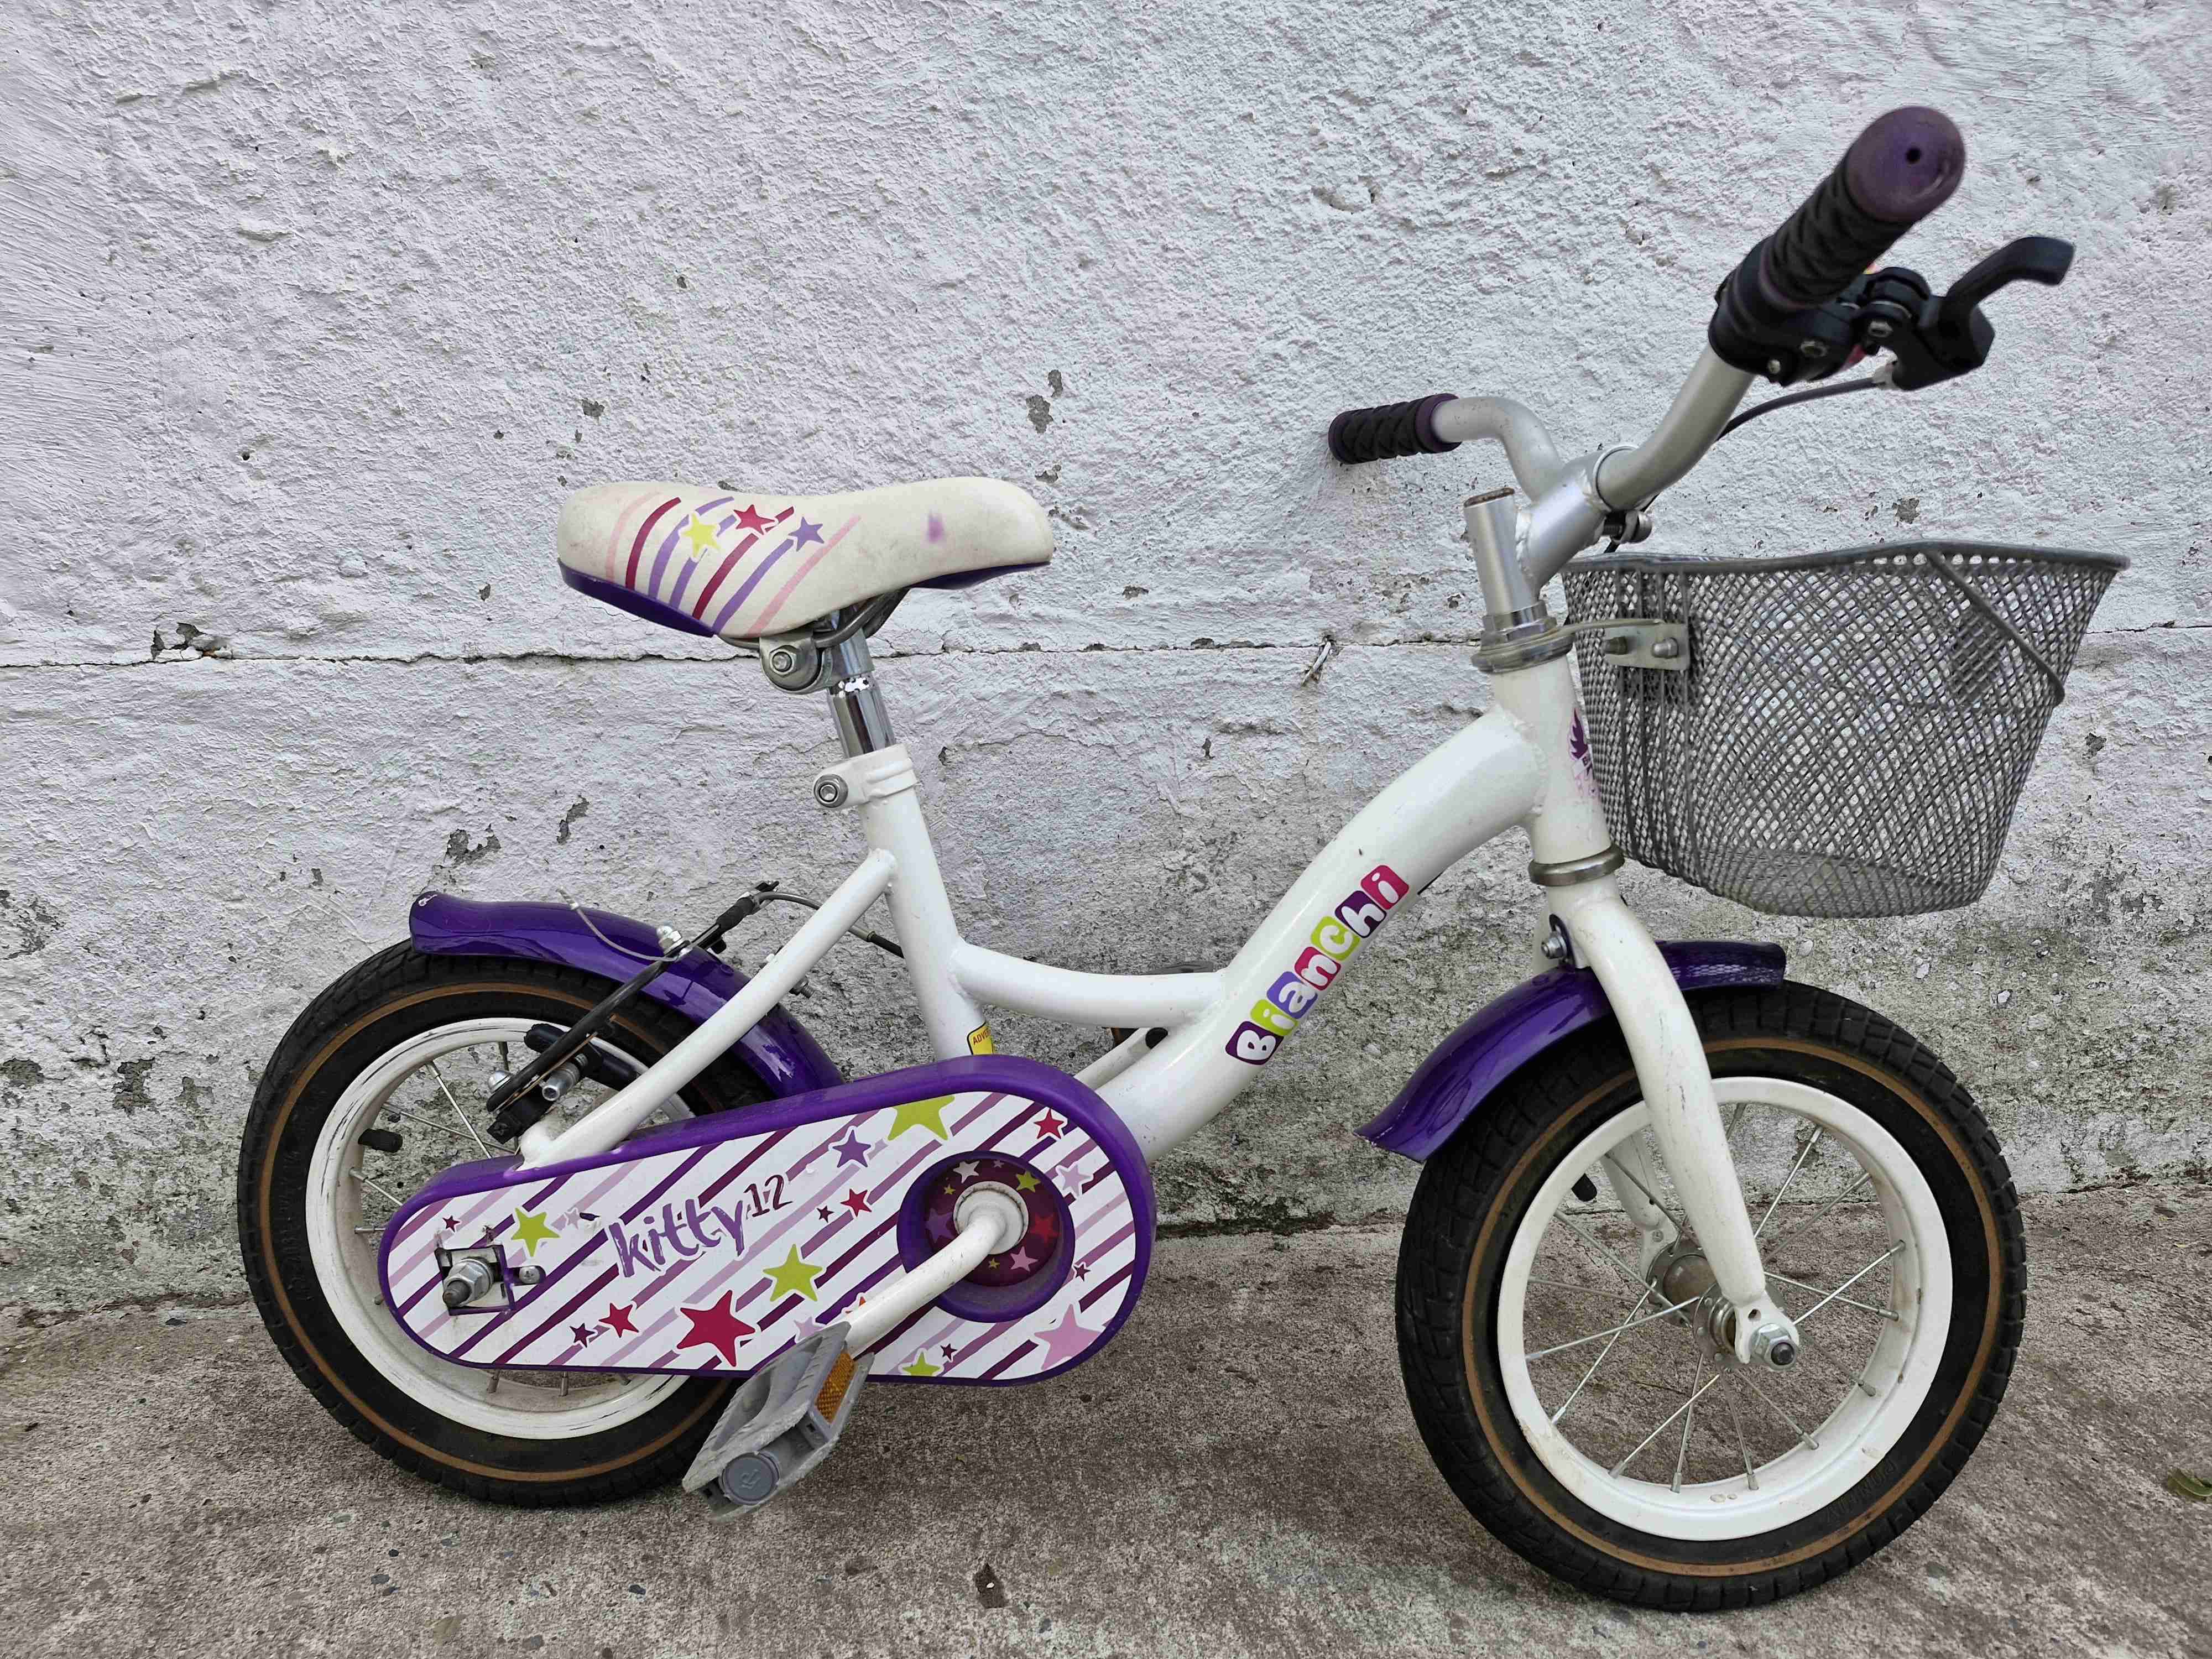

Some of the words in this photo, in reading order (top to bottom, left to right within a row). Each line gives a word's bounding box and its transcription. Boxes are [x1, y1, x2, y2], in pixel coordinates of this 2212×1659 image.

[1235, 870, 1400, 1061] Bianchi
[609, 1199, 745, 1277] kitty
[743, 1174, 793, 1217] 12
